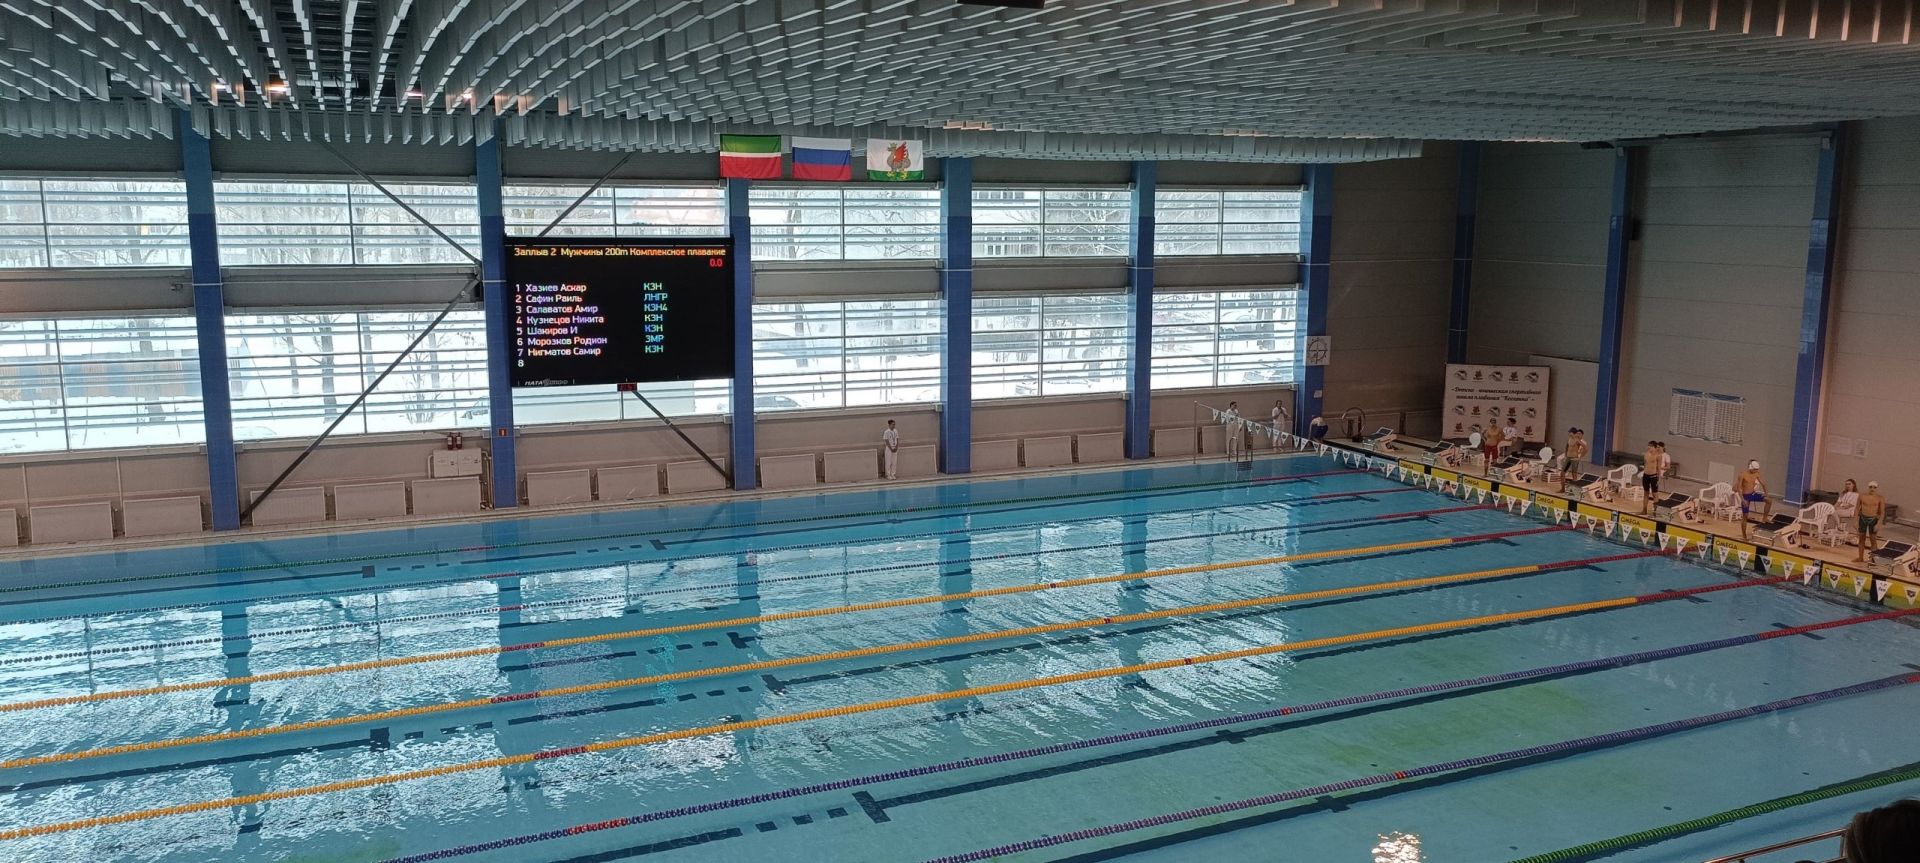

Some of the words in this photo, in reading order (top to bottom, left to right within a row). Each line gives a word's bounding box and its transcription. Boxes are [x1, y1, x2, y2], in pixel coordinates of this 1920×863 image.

[514, 247, 549, 256] Заплыв
[550, 247, 557, 256] 2
[560, 247, 603, 258] Мужчины
[629, 247, 686, 256] Комплексное
[687, 248, 726, 256] плавание
[709, 258, 723, 268] 0.0
[525, 283, 558, 292] Хазиев
[560, 283, 587, 293] Аскар
[643, 282, 662, 291] КЗН
[515, 294, 522, 303] 2
[526, 294, 554, 304] Сафин
[555, 294, 583, 303] Раиль
[643, 293, 668, 301] ЛНГР
[515, 305, 522, 314] 3
[526, 305, 573, 313] Салаватов
[574, 304, 598, 314] Амир
[516, 316, 522, 325] 4
[526, 316, 570, 326] Кузнецов
[572, 315, 604, 324] Никита
[644, 314, 663, 322] КЗН
[516, 327, 523, 336] 5
[527, 327, 568, 336] Шакиров
[570, 326, 578, 334] И
[644, 324, 663, 332] КЗН
[517, 338, 523, 346] 6
[527, 337, 572, 347] Морозков
[573, 336, 608, 346] Родион
[517, 348, 524, 357] 7
[527, 348, 571, 357] Нигматов
[573, 347, 601, 356] Самир
[645, 345, 664, 353] КЗН
[517, 359, 524, 368] 8
[1536, 496, 1554, 504] OMEGA
[1620, 516, 1640, 525] OMEGA
[1715, 540, 1738, 550] OMEGA
